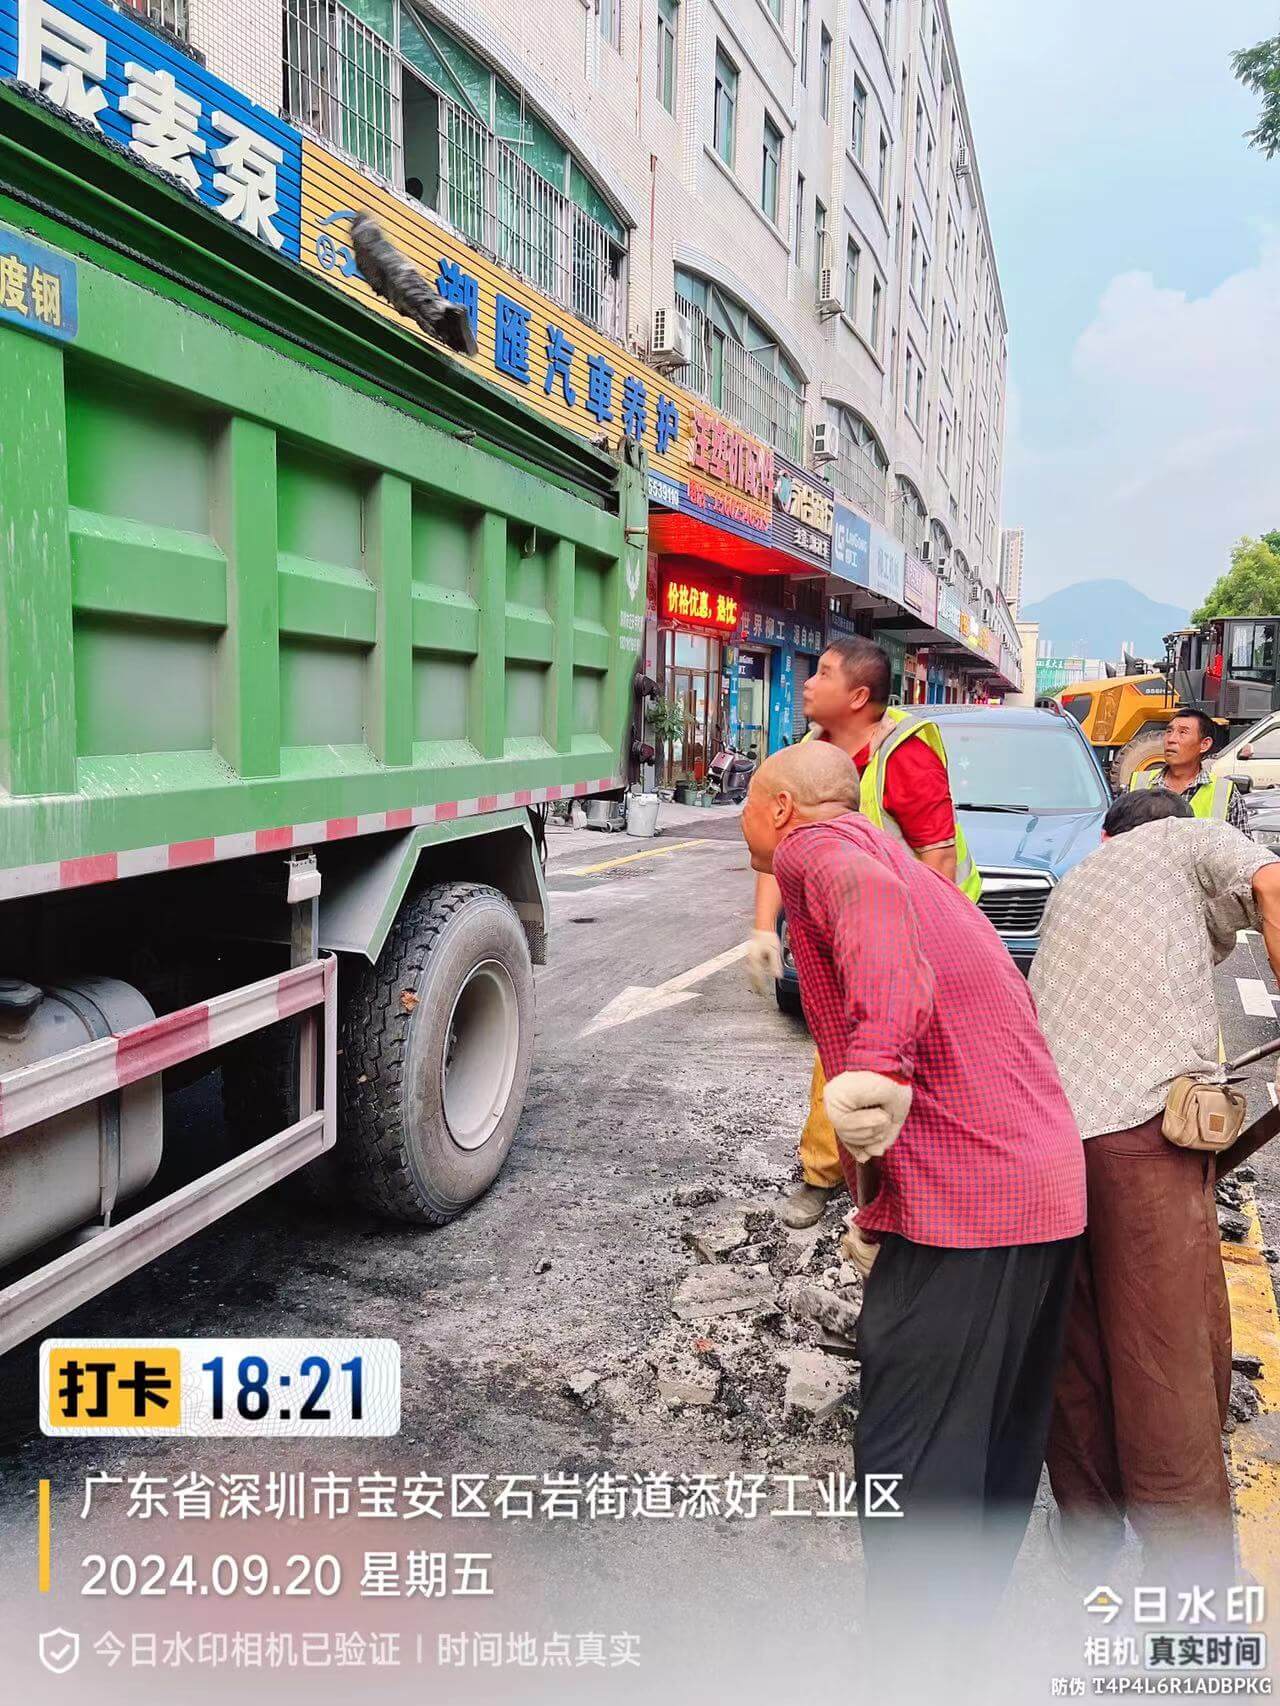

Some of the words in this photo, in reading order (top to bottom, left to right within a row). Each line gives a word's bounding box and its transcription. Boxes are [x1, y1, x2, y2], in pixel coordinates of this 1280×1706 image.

[17, 0, 285, 250] 尿素泵
[0, 255, 61, 326] 度钢
